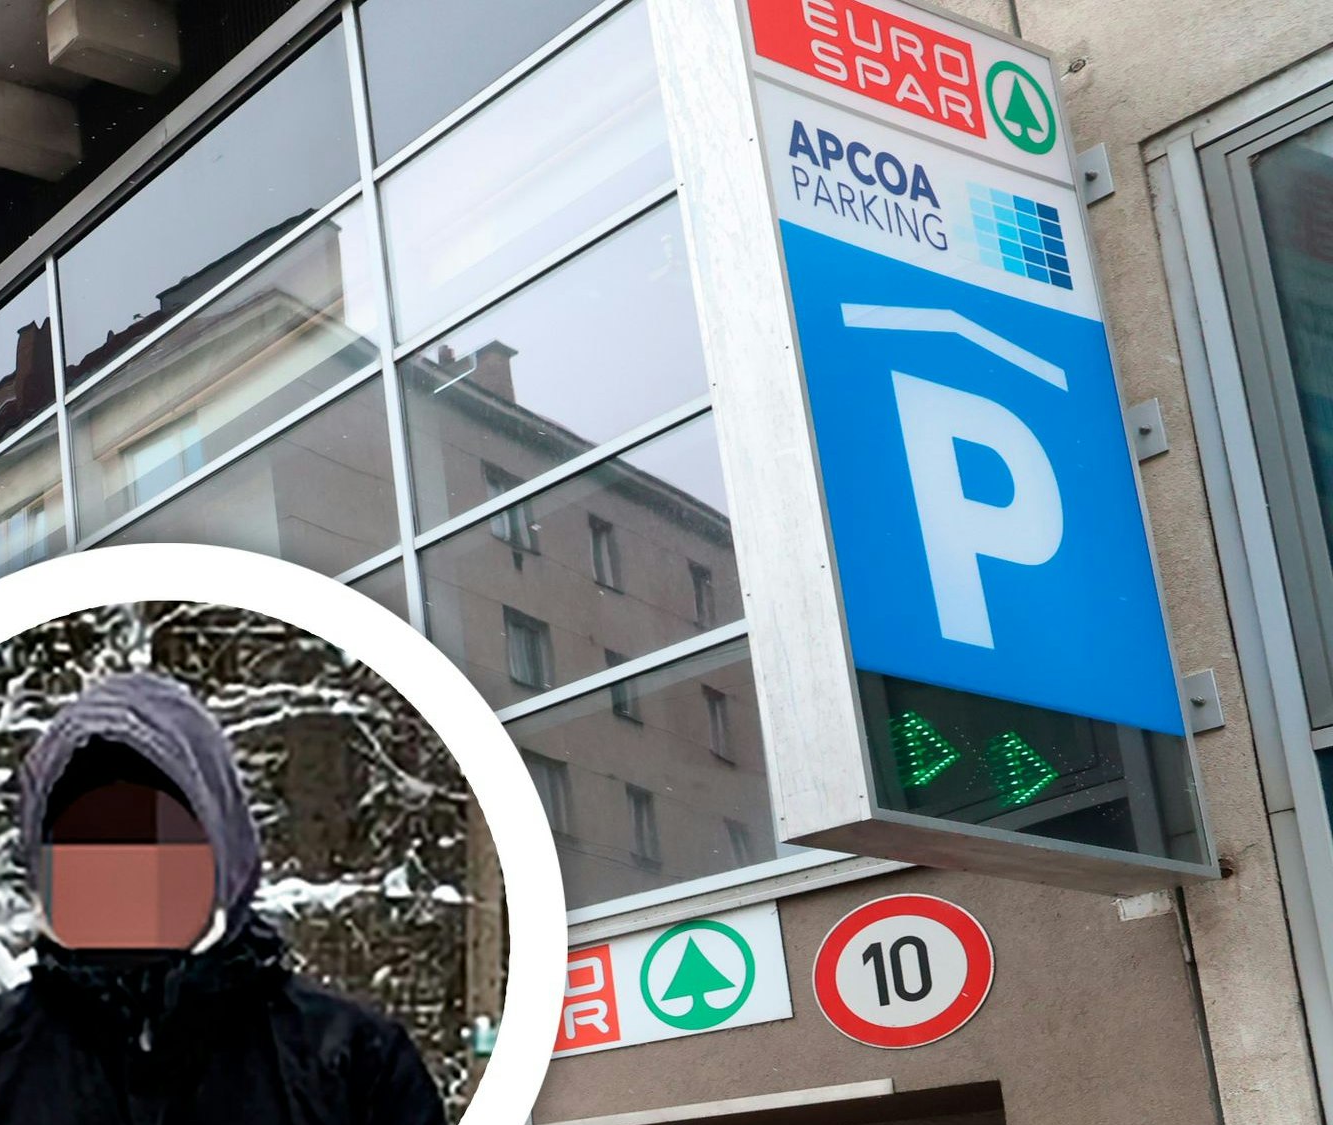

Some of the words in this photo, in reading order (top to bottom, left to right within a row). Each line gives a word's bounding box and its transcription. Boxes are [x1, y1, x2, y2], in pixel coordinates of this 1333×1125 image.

[801, 0, 969, 86] EURO
[810, 39, 975, 129] SPAR
[789, 119, 941, 209] APCOA
[792, 165, 948, 251] PARKING
[891, 369, 1064, 650] P
[862, 935, 933, 1006] 10
